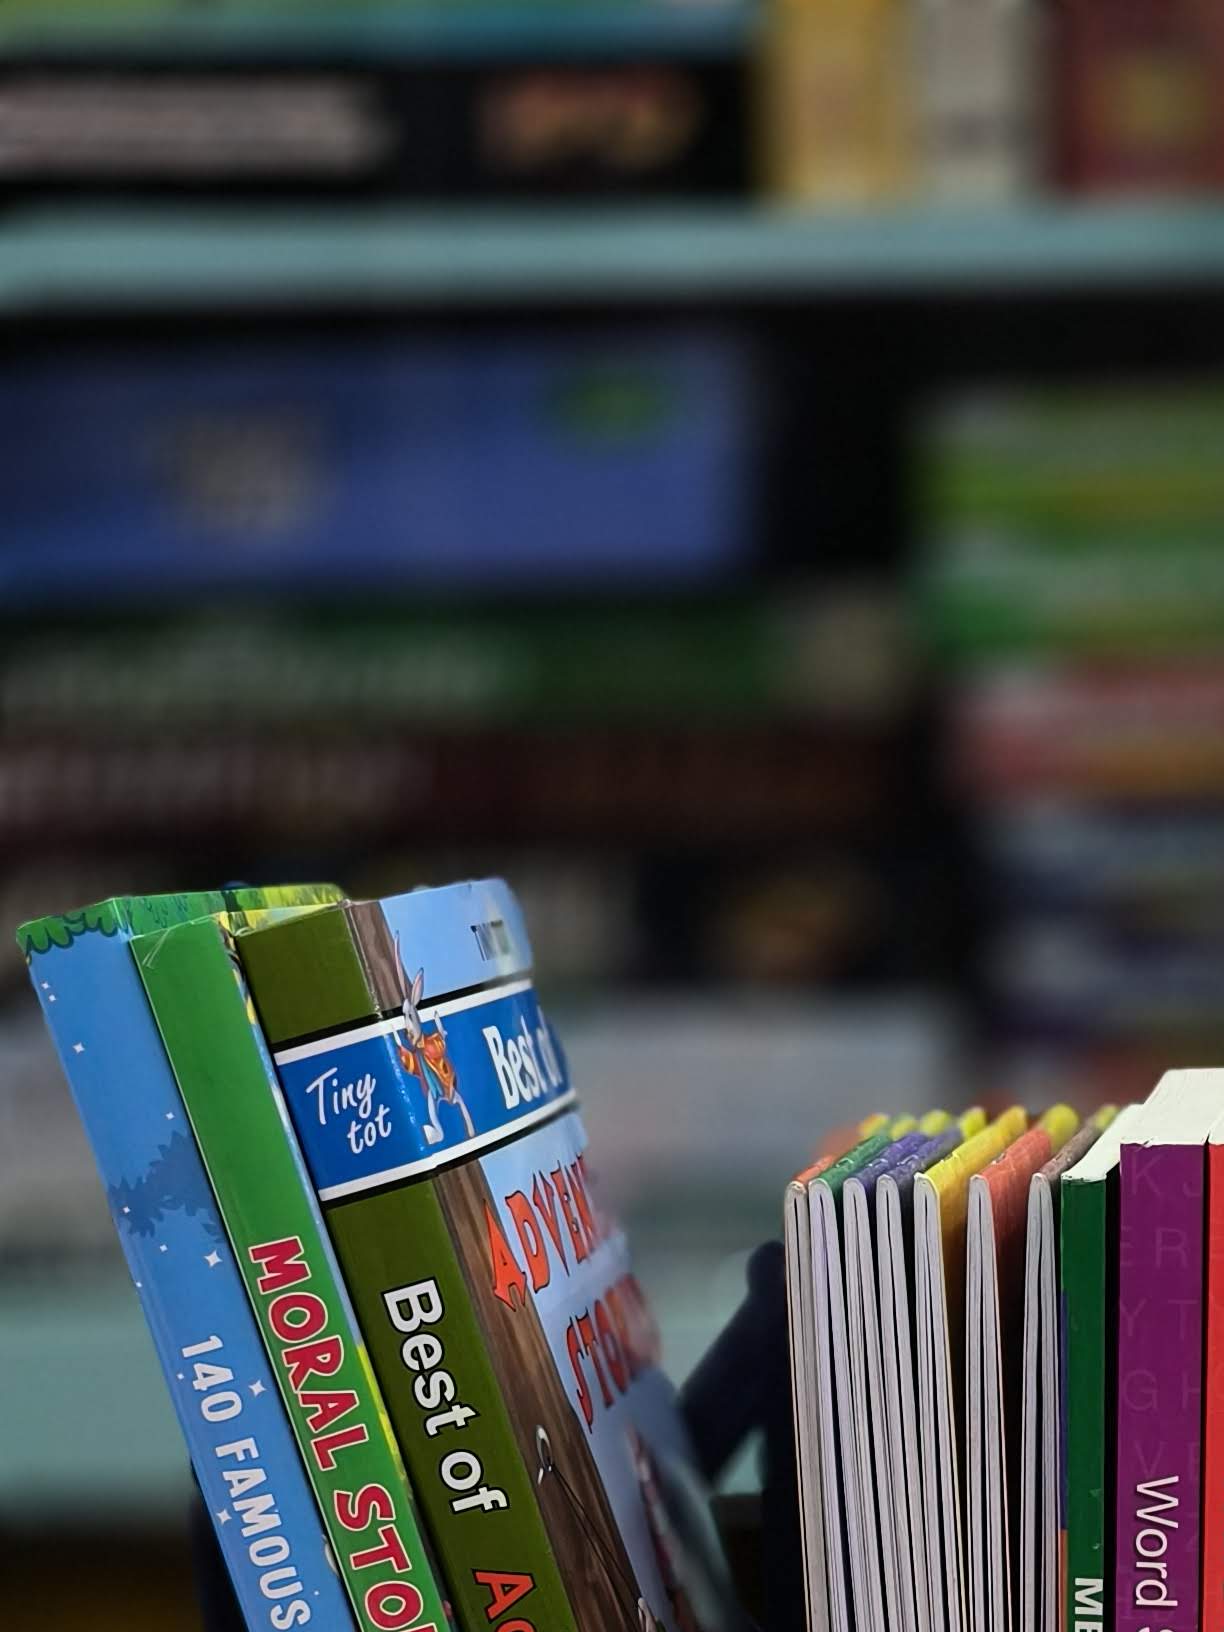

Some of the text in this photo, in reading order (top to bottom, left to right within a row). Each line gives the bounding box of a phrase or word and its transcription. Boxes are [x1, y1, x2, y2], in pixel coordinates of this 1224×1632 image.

[306, 1066, 377, 1125] Tiny
[482, 1015, 548, 1110] Best
[347, 1106, 394, 1155] tot
[248, 1235, 367, 1472] MORAL
[381, 1276, 482, 1436] Best
[440, 1450, 510, 1515] of
[181, 1335, 241, 1423] 140
[216, 1437, 310, 1630] FAMOUS
[1134, 1476, 1180, 1608] Word
